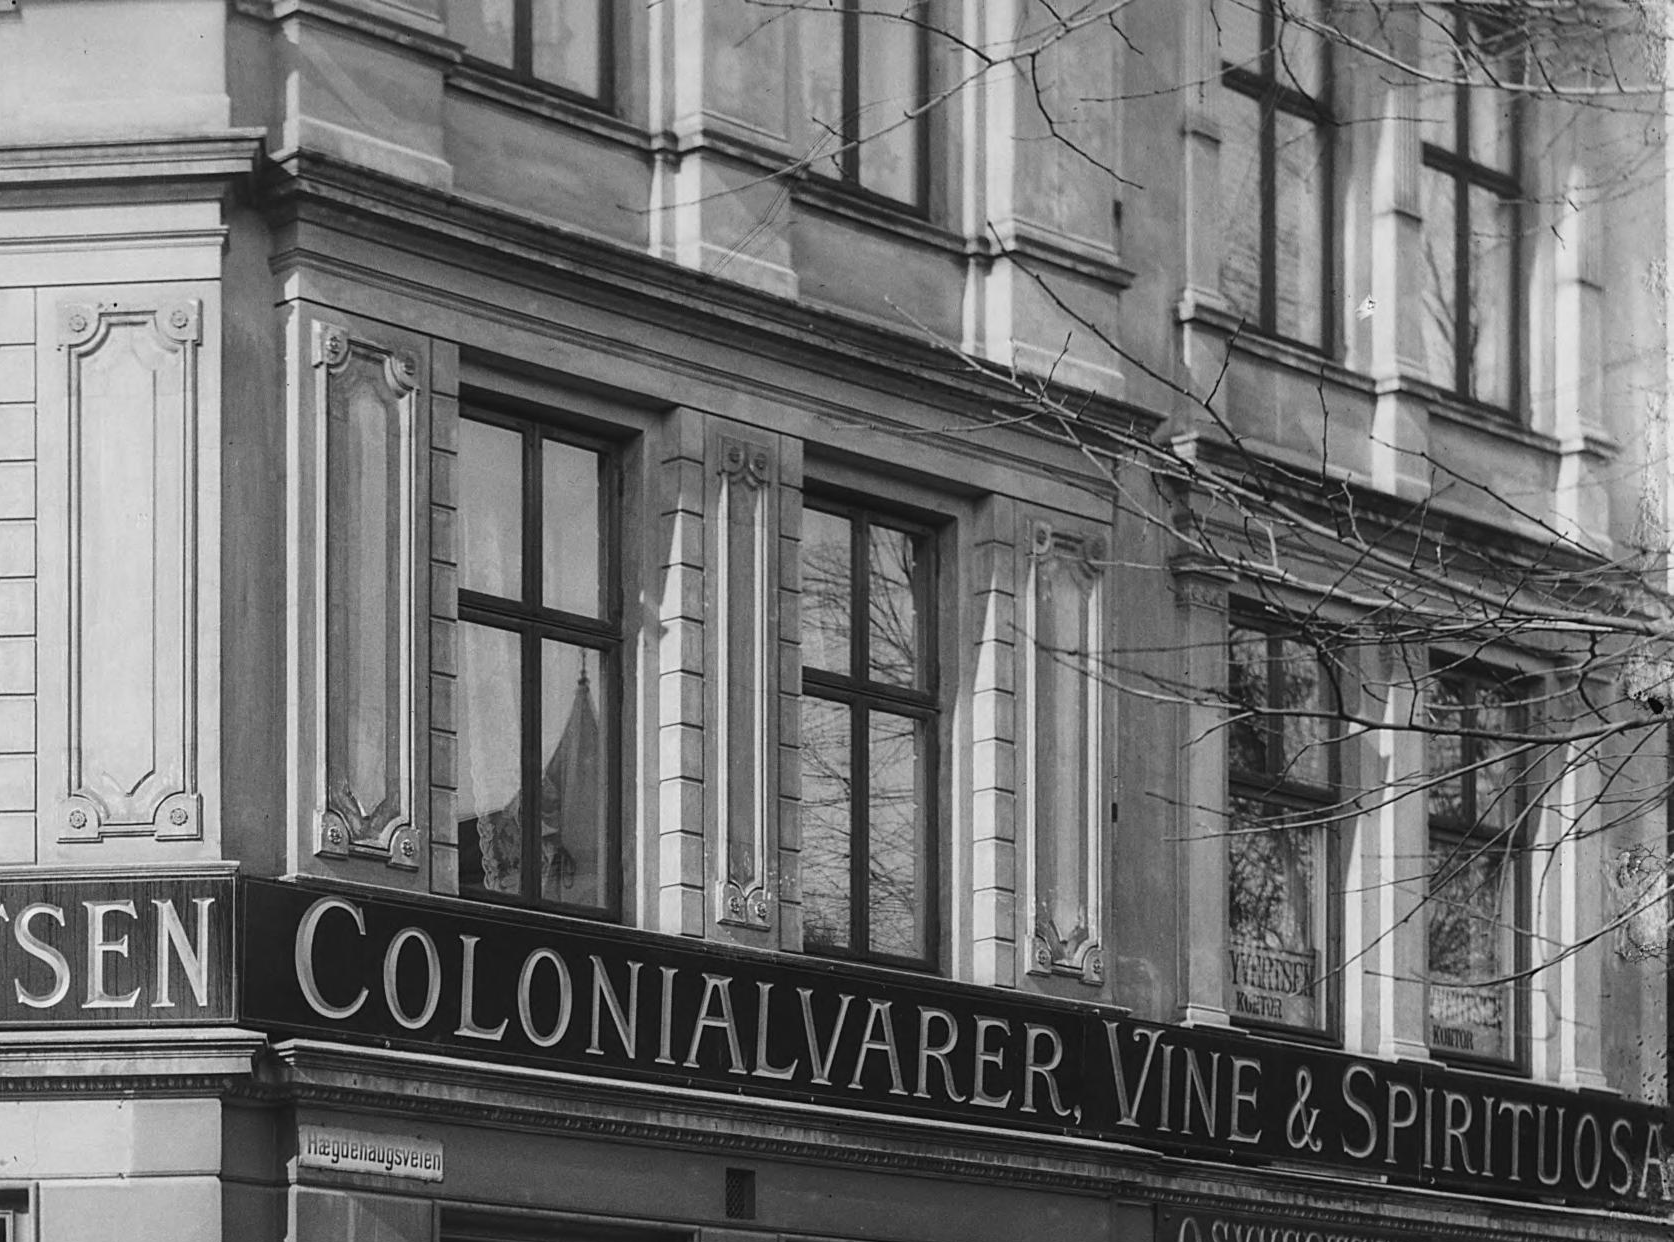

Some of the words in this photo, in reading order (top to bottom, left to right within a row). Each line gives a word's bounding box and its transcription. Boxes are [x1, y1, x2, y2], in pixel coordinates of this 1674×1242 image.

[294, 897, 1082, 1125] COLONIALVARER,
[1102, 1019, 1263, 1144] VINE
[1285, 1065, 1323, 1151] &
[1341, 1063, 1673, 1201] SPIRITUOSA
